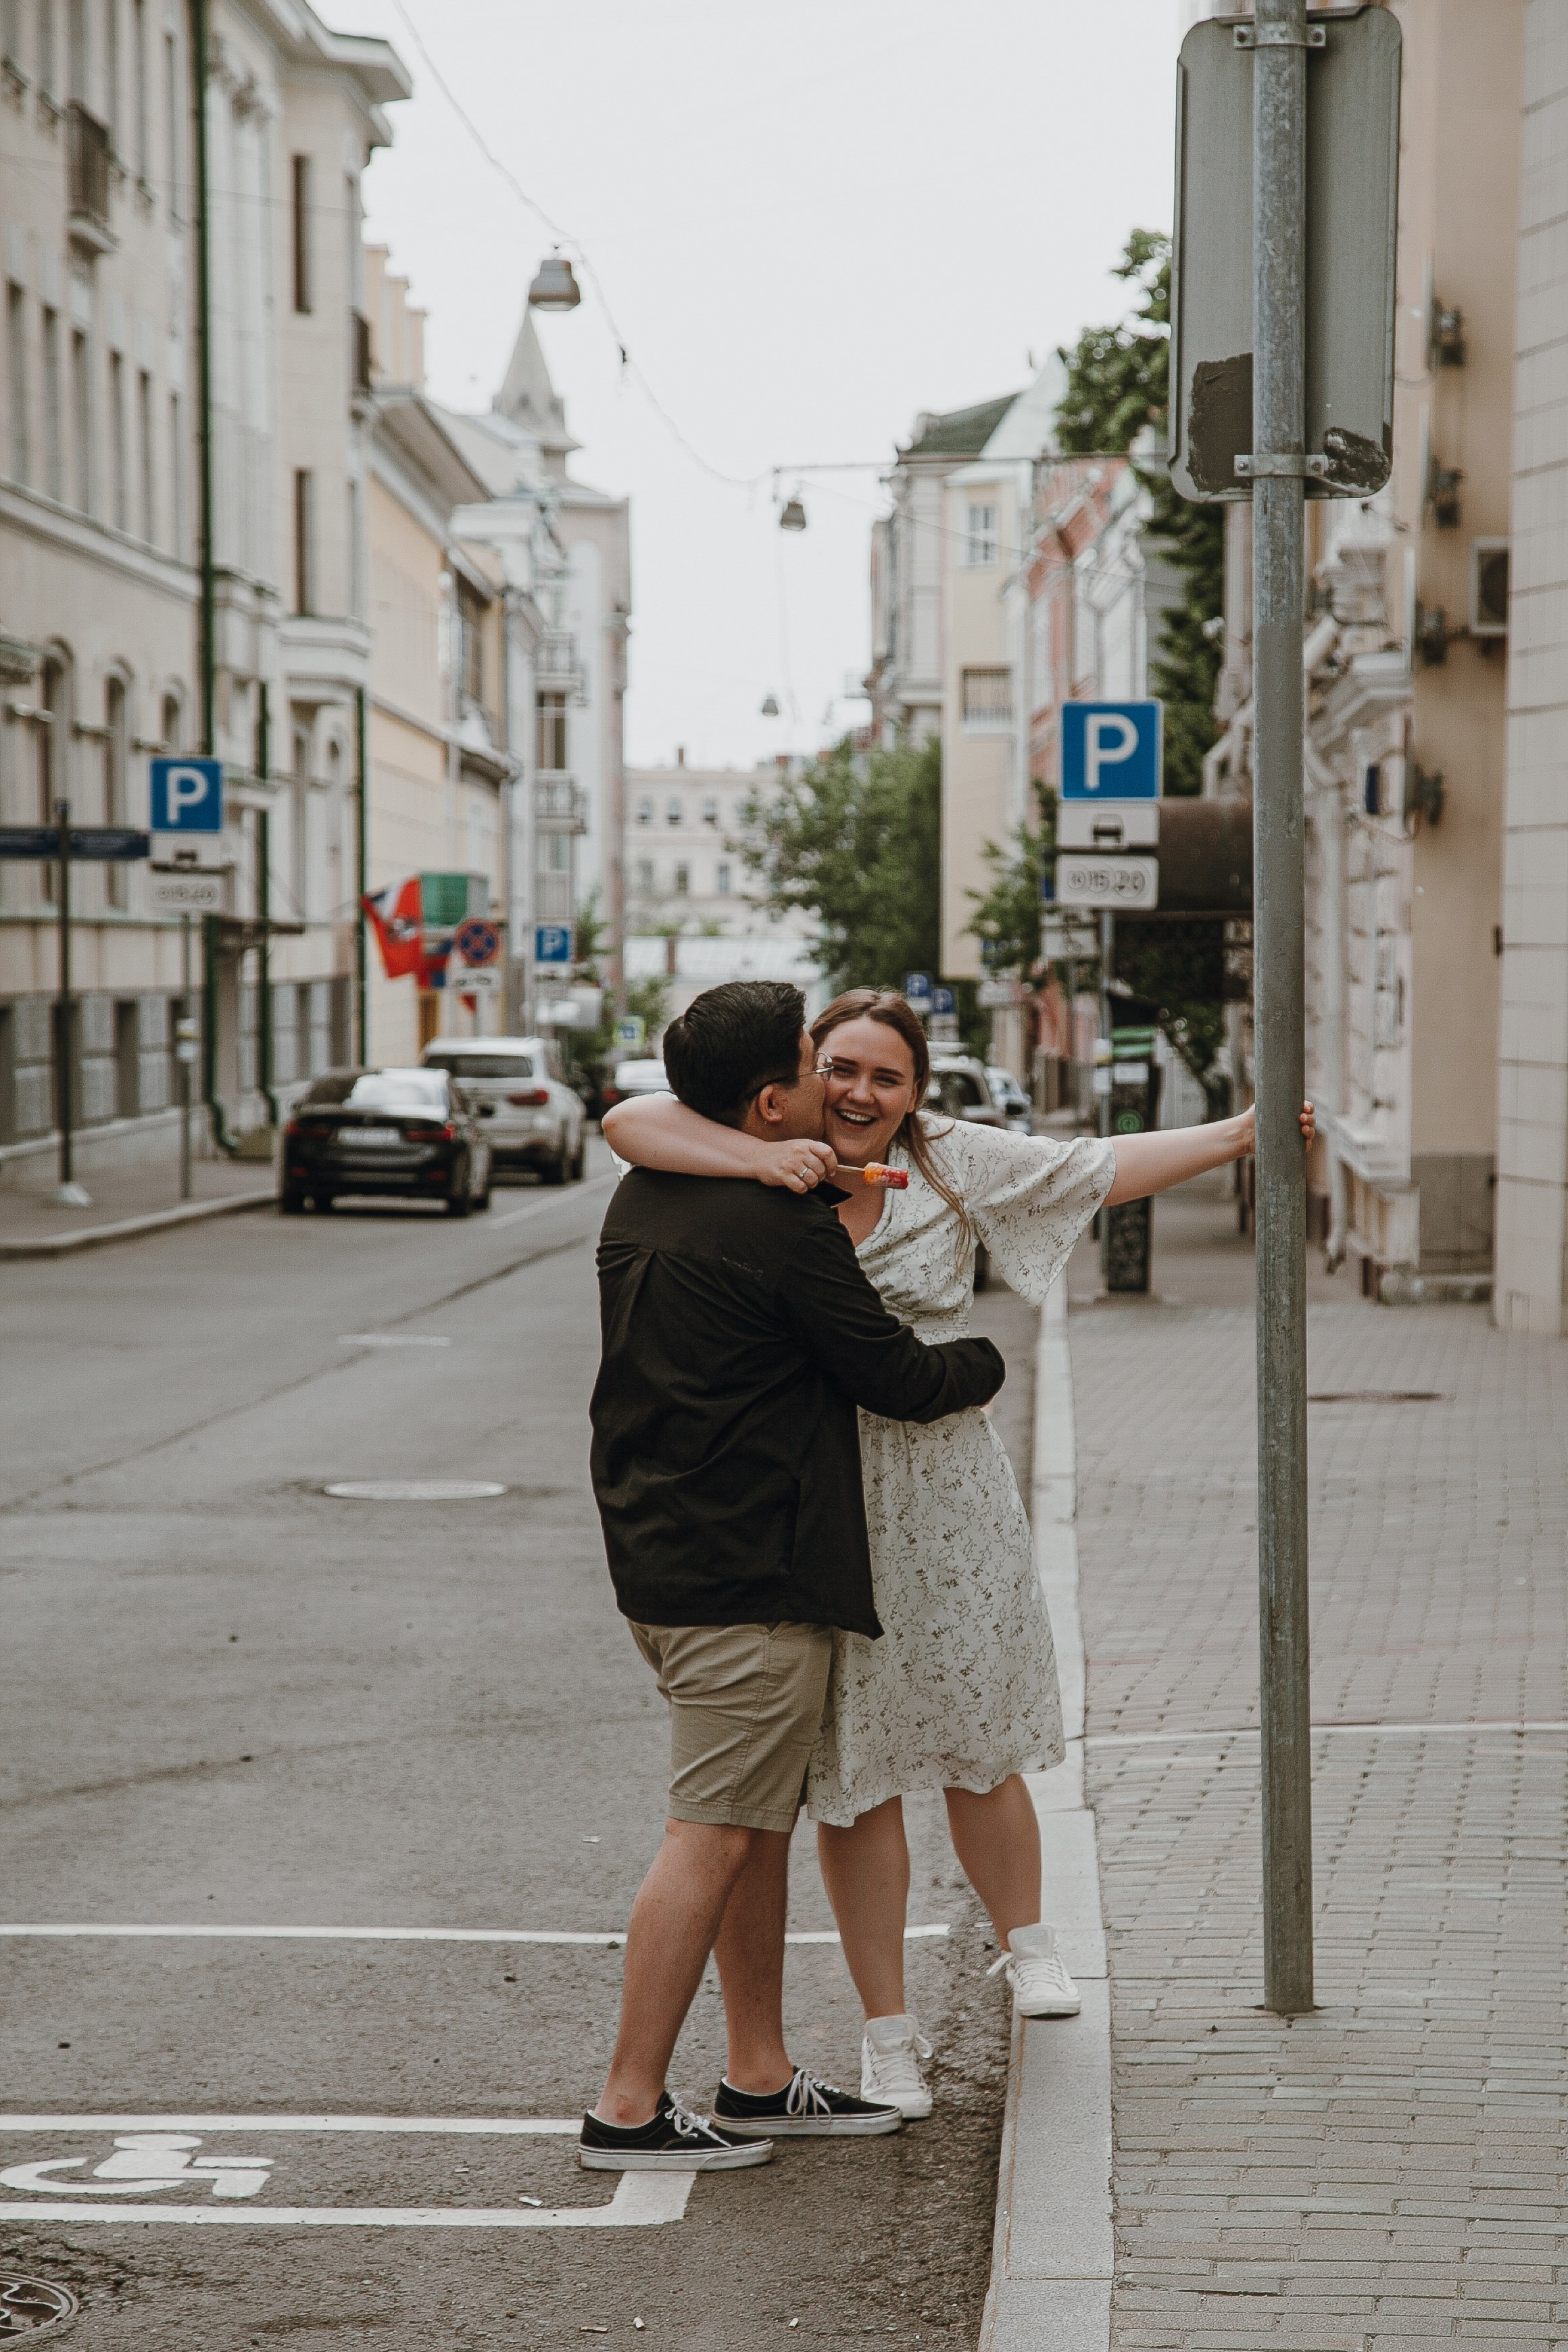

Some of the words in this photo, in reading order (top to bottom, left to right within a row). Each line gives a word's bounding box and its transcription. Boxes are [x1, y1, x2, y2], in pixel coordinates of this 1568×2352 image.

[1085, 713, 1138, 789] P
[167, 767, 209, 824] P
[543, 928, 564, 954] P
